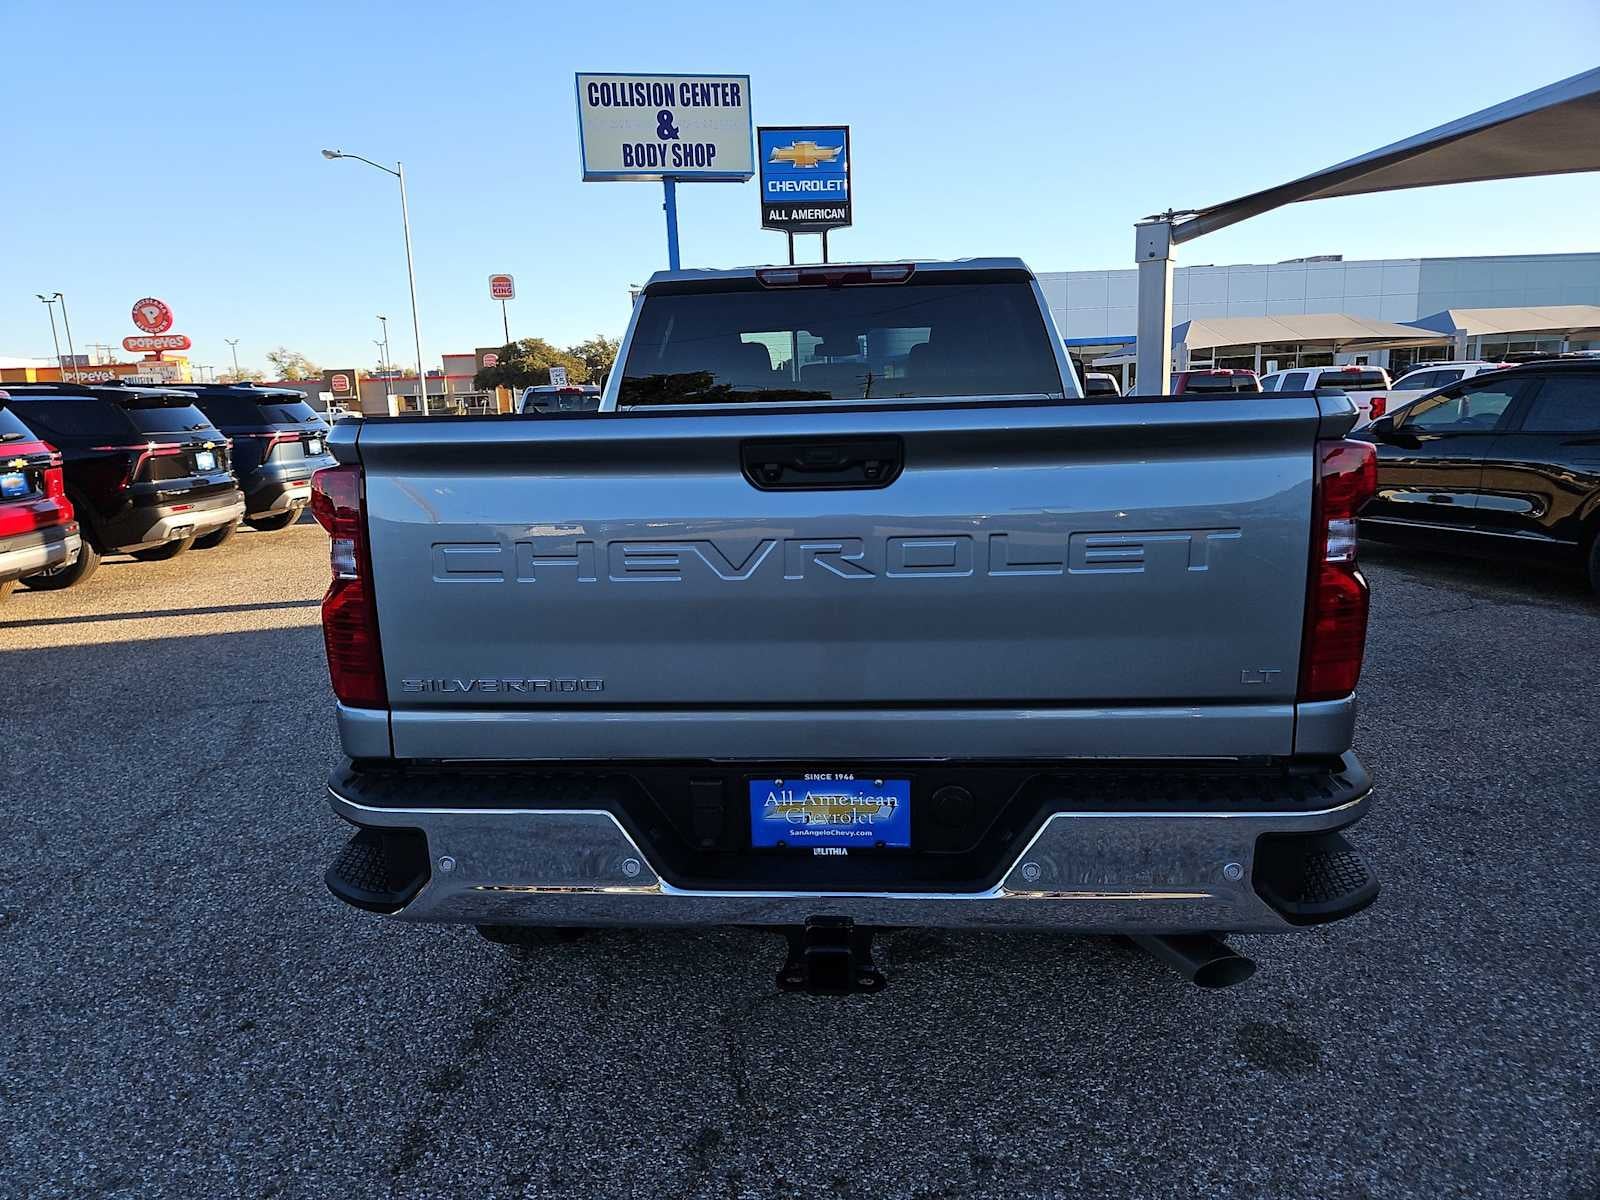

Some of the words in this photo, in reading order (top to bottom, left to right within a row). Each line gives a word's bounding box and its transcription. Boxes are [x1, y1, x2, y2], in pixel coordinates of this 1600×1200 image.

[587, 82, 675, 107] COLLISION
[679, 83, 742, 108] CENTER
[656, 109, 680, 140] &
[622, 143, 668, 167] BODY
[672, 143, 717, 168] SHOP
[768, 180, 844, 193] CHEVROLET
[768, 208, 789, 221] ALL
[791, 208, 846, 221] AMERICAN
[431, 526, 1242, 584] CHEVROLET
[1240, 668, 1282, 685] LT
[401, 678, 606, 694] SILVERADO
[804, 773, 833, 781] SINCE
[834, 773, 855, 781] 1946
[763, 790, 794, 808] All
[804, 791, 900, 808] American
[785, 806, 875, 826] Chevrolet
[789, 829, 873, 838] SanAngeloChevy.com
[820, 847, 848, 856] LITHIA
